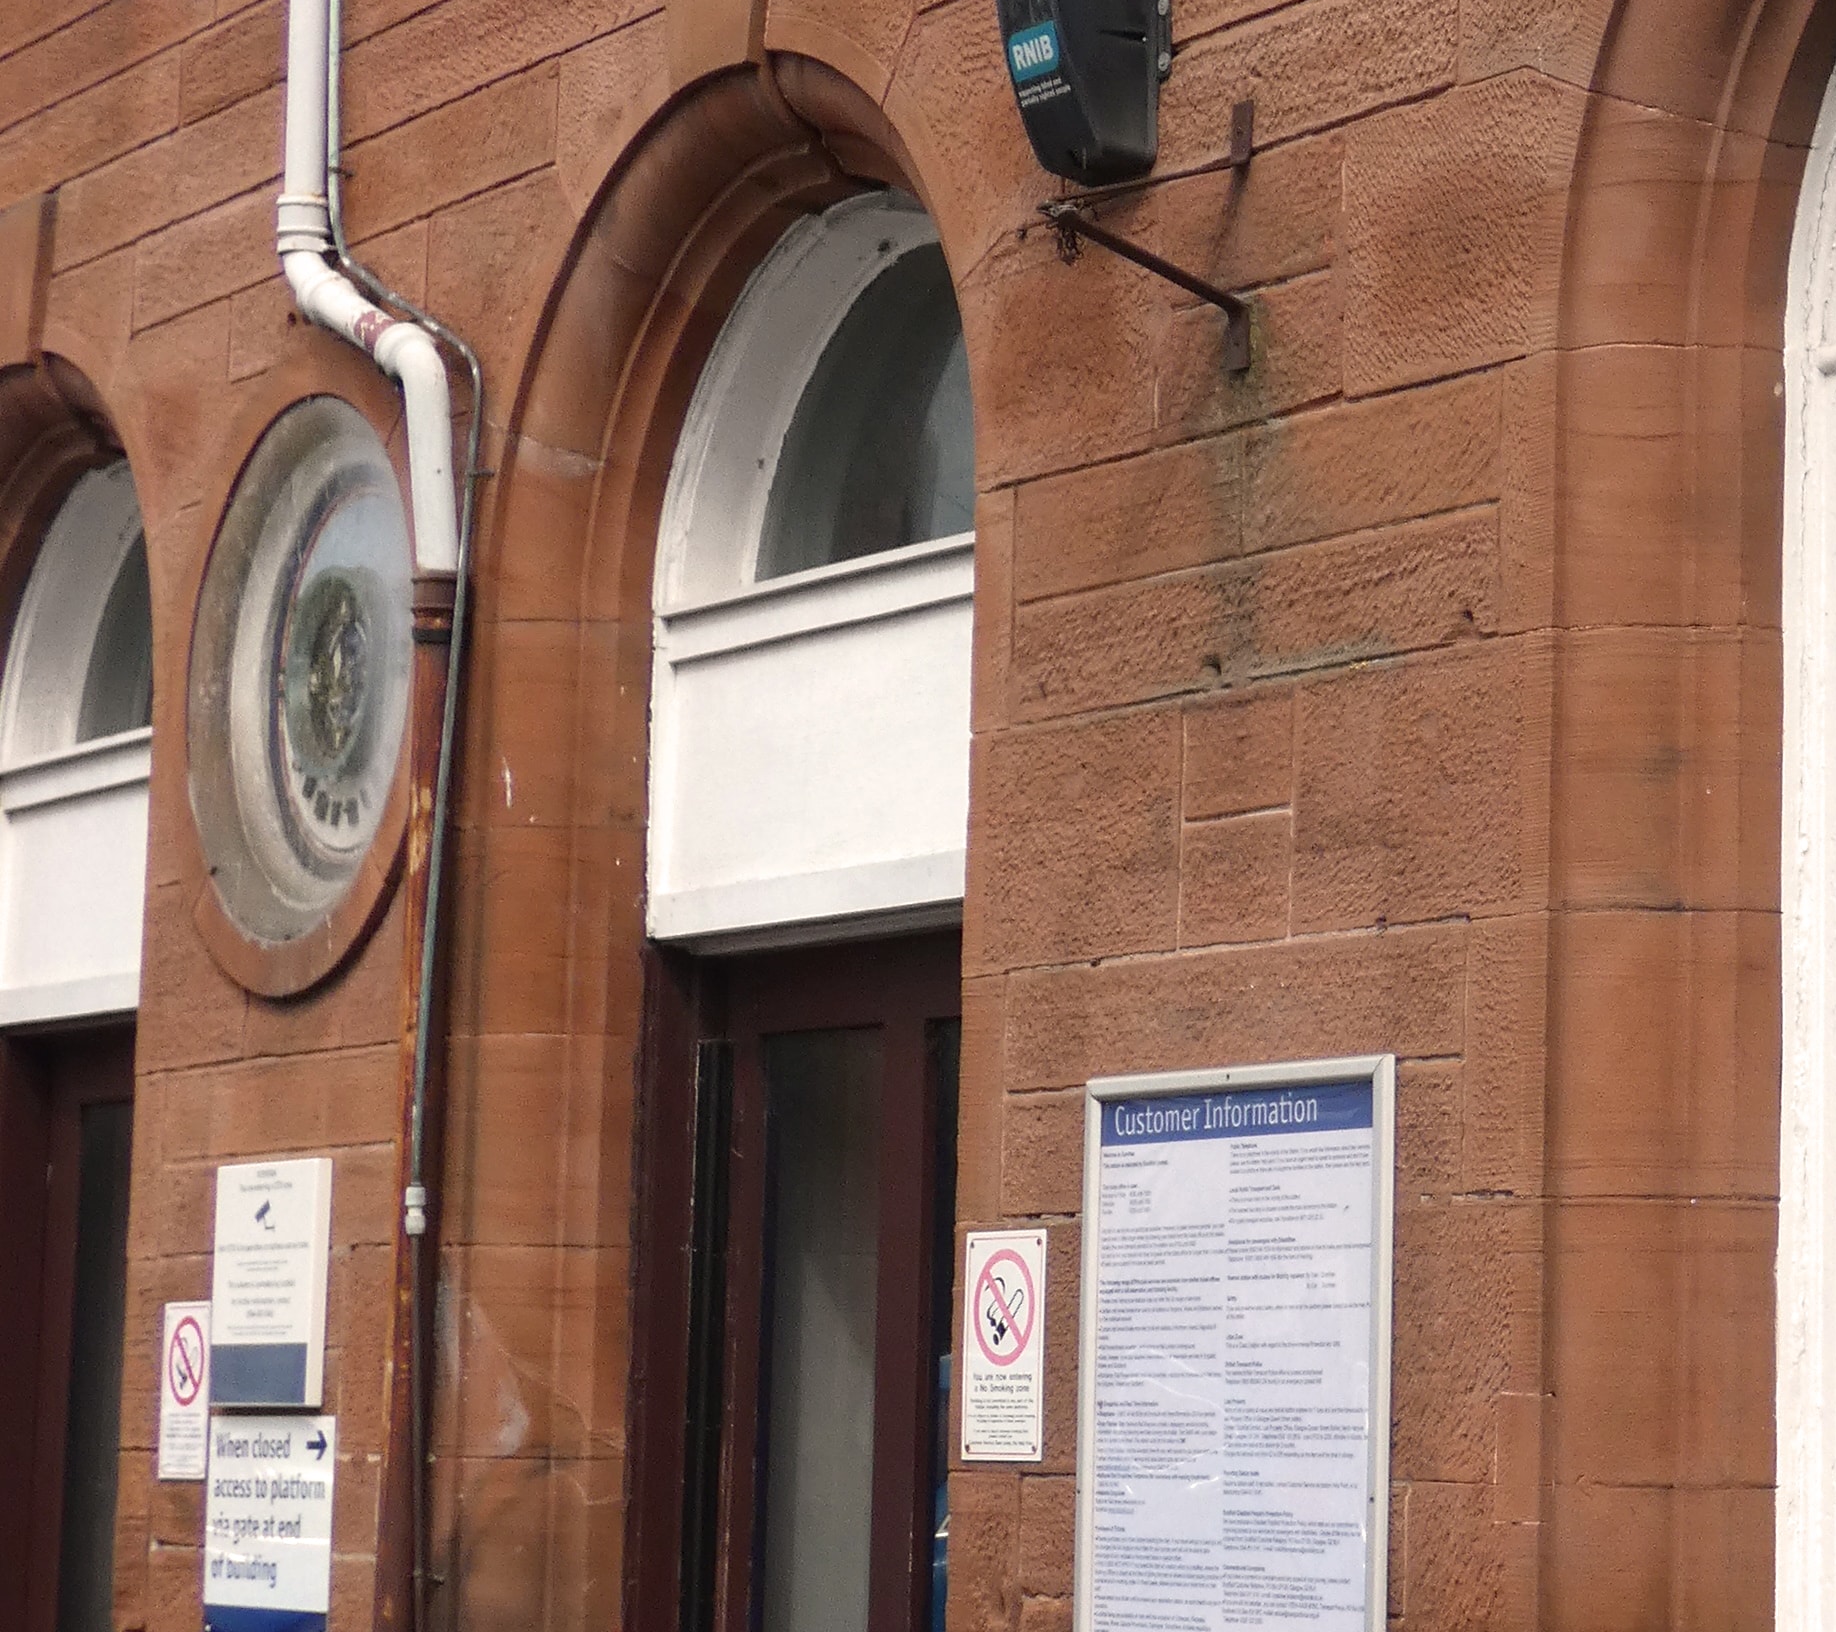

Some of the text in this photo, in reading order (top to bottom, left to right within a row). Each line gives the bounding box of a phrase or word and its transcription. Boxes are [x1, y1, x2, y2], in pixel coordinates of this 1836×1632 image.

[1012, 34, 1054, 71] RNIB
[1115, 1091, 1319, 1136] Customer Information
[980, 1384, 988, 1392] No
[990, 1384, 1014, 1394] Smoking
[215, 1432, 249, 1458] When
[252, 1431, 291, 1458] closed
[213, 1473, 326, 1504] access to platform
[212, 1511, 301, 1544] via gate at end
